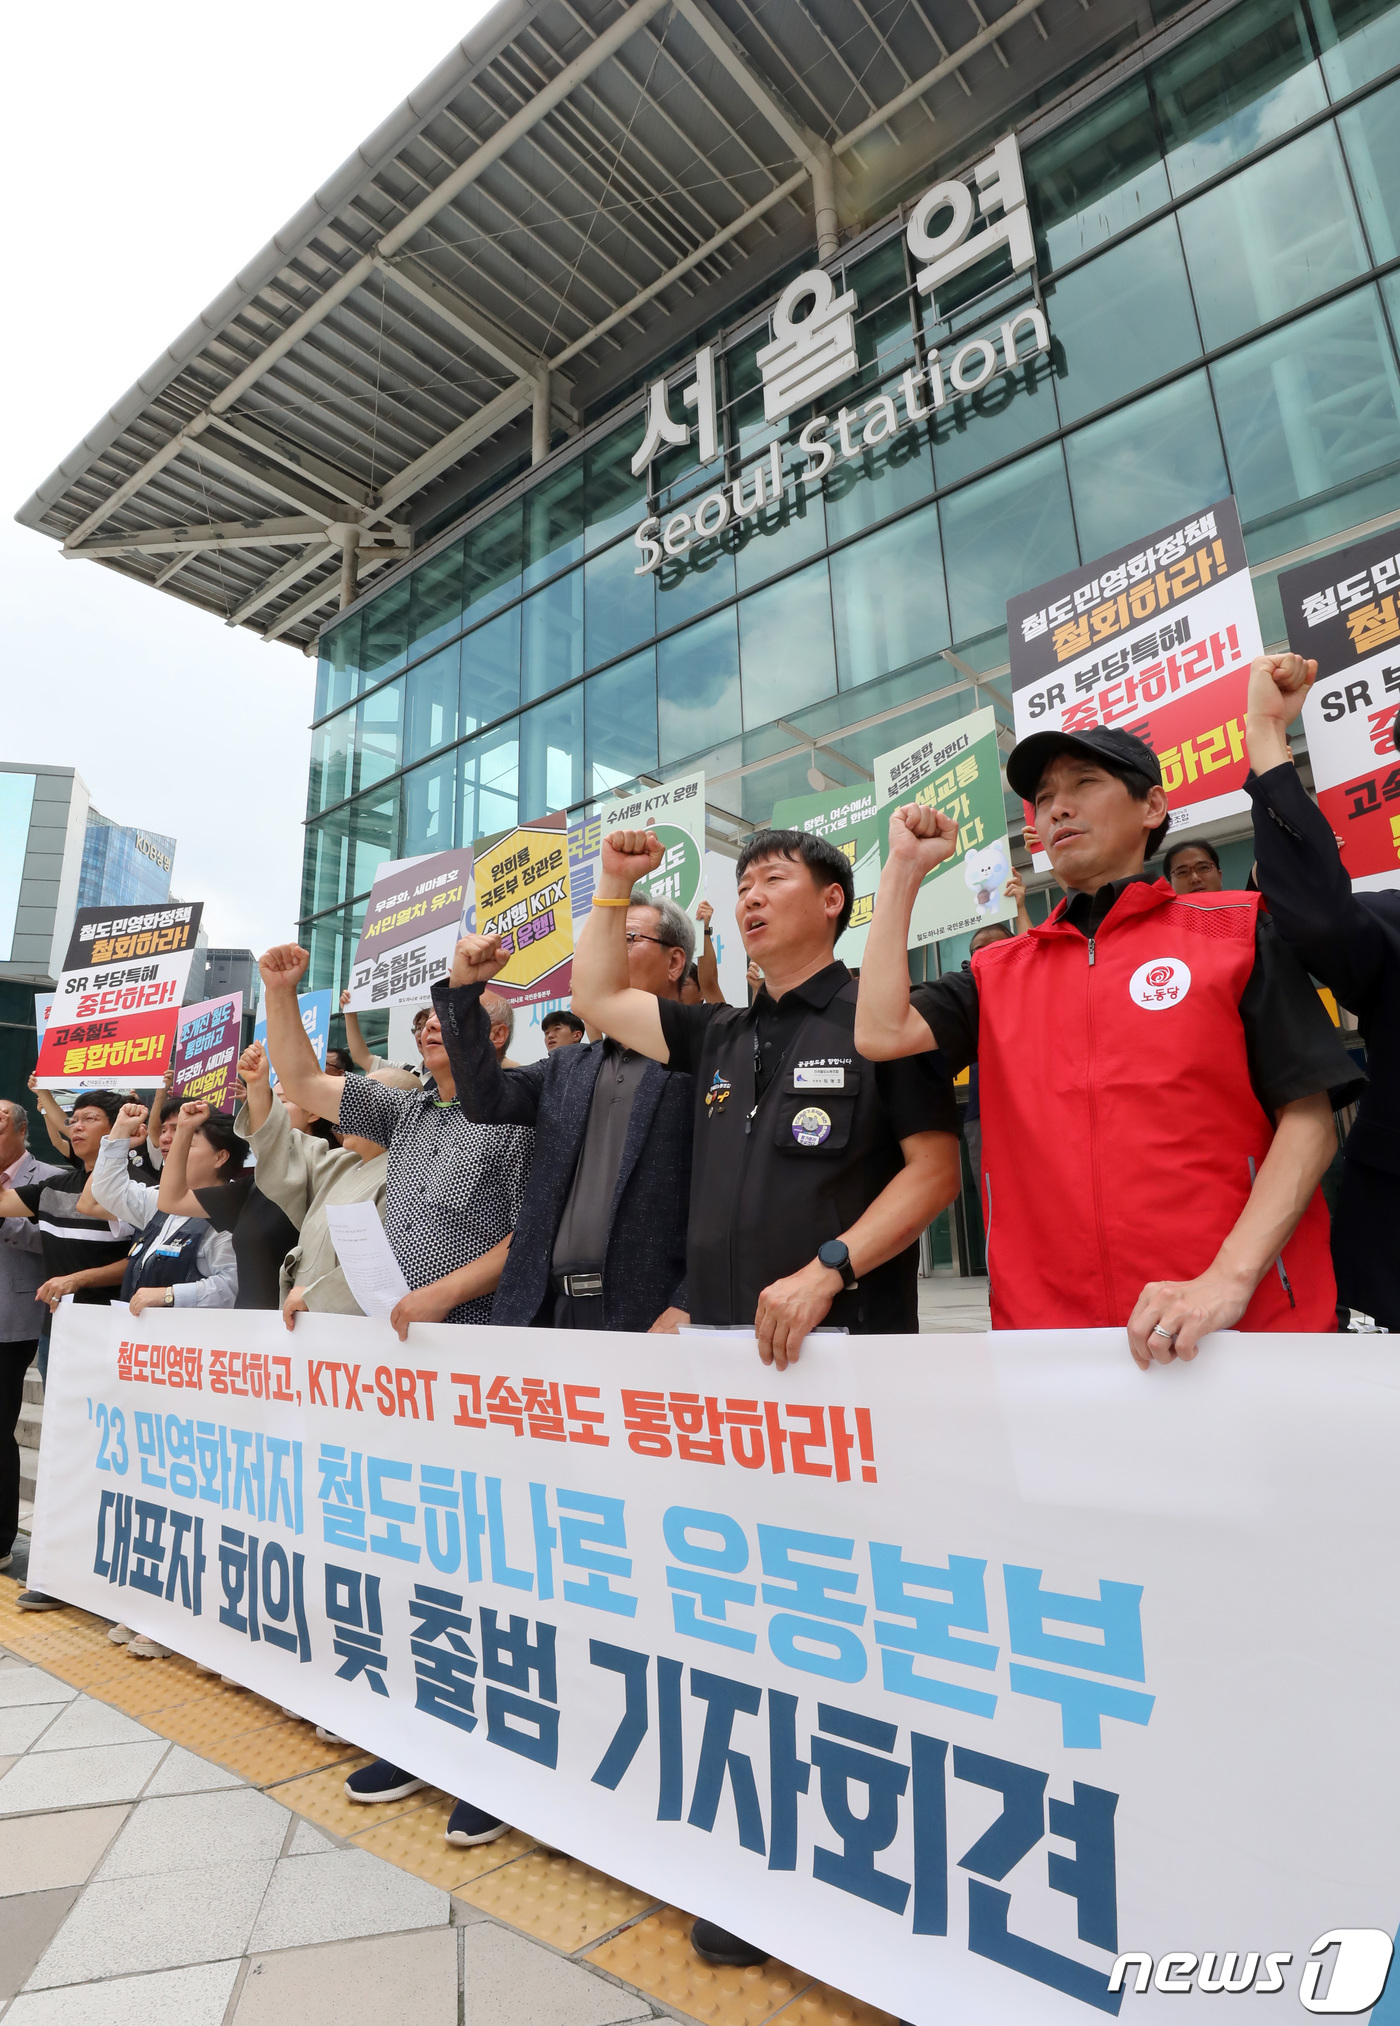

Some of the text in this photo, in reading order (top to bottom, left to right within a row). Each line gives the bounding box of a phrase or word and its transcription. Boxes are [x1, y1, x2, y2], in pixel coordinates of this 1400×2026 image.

[632, 133, 1036, 476] 서울역
[634, 306, 1051, 576] Seoul Station
[1021, 511, 1218, 643] 철도민영화정책
[1052, 538, 1228, 662] 철회하라!
[1028, 615, 1192, 719] SR 부당특혜
[1060, 623, 1242, 734] 중단하라!
[1320, 679, 1373, 724] SR
[887, 733, 970, 799] 북극곰도 원한다
[889, 741, 934, 782] 철도통합
[607, 781, 699, 825] 수서행 KTX 운행
[804, 795, 872, 832] 창원, 여수에서
[135, 834, 171, 872] KDB생명
[491, 846, 531, 883] 원희룡
[374, 869, 459, 913] 무궁화, 새마을호
[480, 848, 563, 909] 국토부 장관은
[79, 906, 193, 942] 철도민영화정책
[364, 900, 428, 940] 서민열차
[431, 885, 463, 912] 유지
[482, 898, 528, 936] 수서행
[531, 875, 568, 916] KTX
[91, 925, 190, 963] 철회하라!
[517, 908, 557, 951] 운행!
[916, 915, 983, 942] 철도하나로 국민운동본부
[65, 964, 159, 994] SR 부당특혜
[353, 945, 427, 990] 고속철도
[371, 956, 448, 1003] 통합하면
[75, 980, 177, 1018] 중단하라!
[211, 1001, 233, 1027] 철도
[1141, 986, 1180, 1002] 노동당
[53, 1020, 119, 1047] 고속철도
[63, 1034, 166, 1074] 통합하라!
[184, 1025, 226, 1060] 통합하고
[175, 1060, 203, 1085] 무궁화,
[117, 1341, 878, 1484] 철도민영화 중단하고, KTX-SRT 고속철도 통합하라!
[87, 1397, 1156, 1750] '23 민영화저지 철도하나로 운동본부
[93, 1489, 1127, 2018] 대표자 회의 및 출범 기자회견
